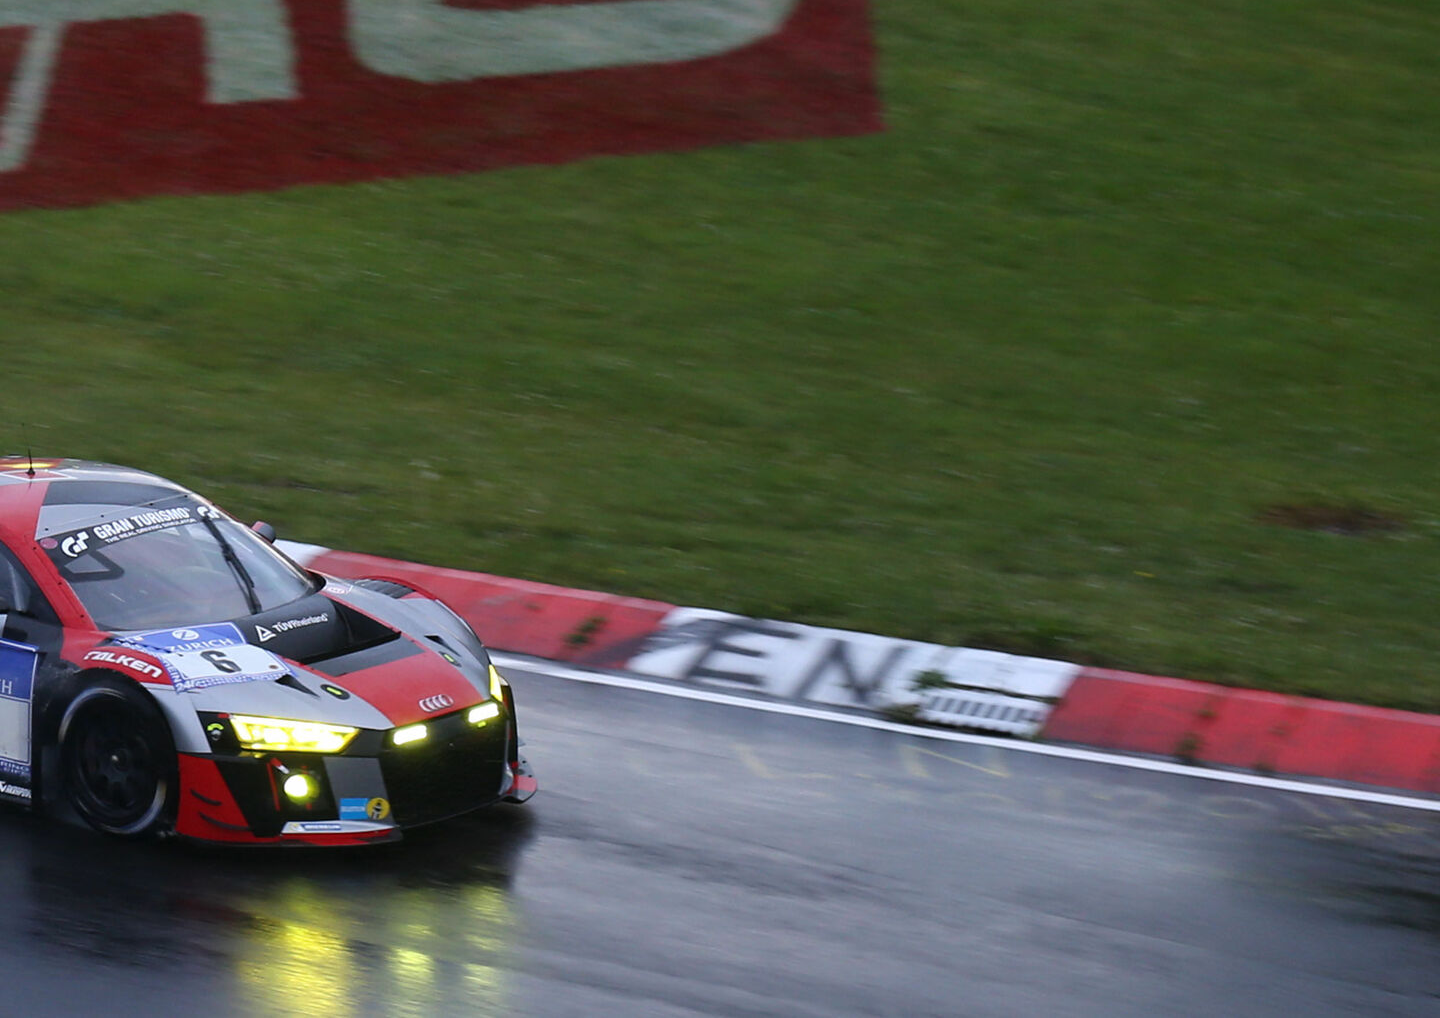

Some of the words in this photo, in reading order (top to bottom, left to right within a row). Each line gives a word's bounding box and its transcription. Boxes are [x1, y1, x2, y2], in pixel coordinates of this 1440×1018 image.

[93, 517, 135, 540] GRAN
[130, 506, 190, 528] TURISMO
[105, 536, 121, 544] THE
[120, 531, 138, 541] REAL
[168, 638, 234, 653] ZURICH
[84, 650, 163, 679] FALKEN
[200, 650, 242, 673] 6
